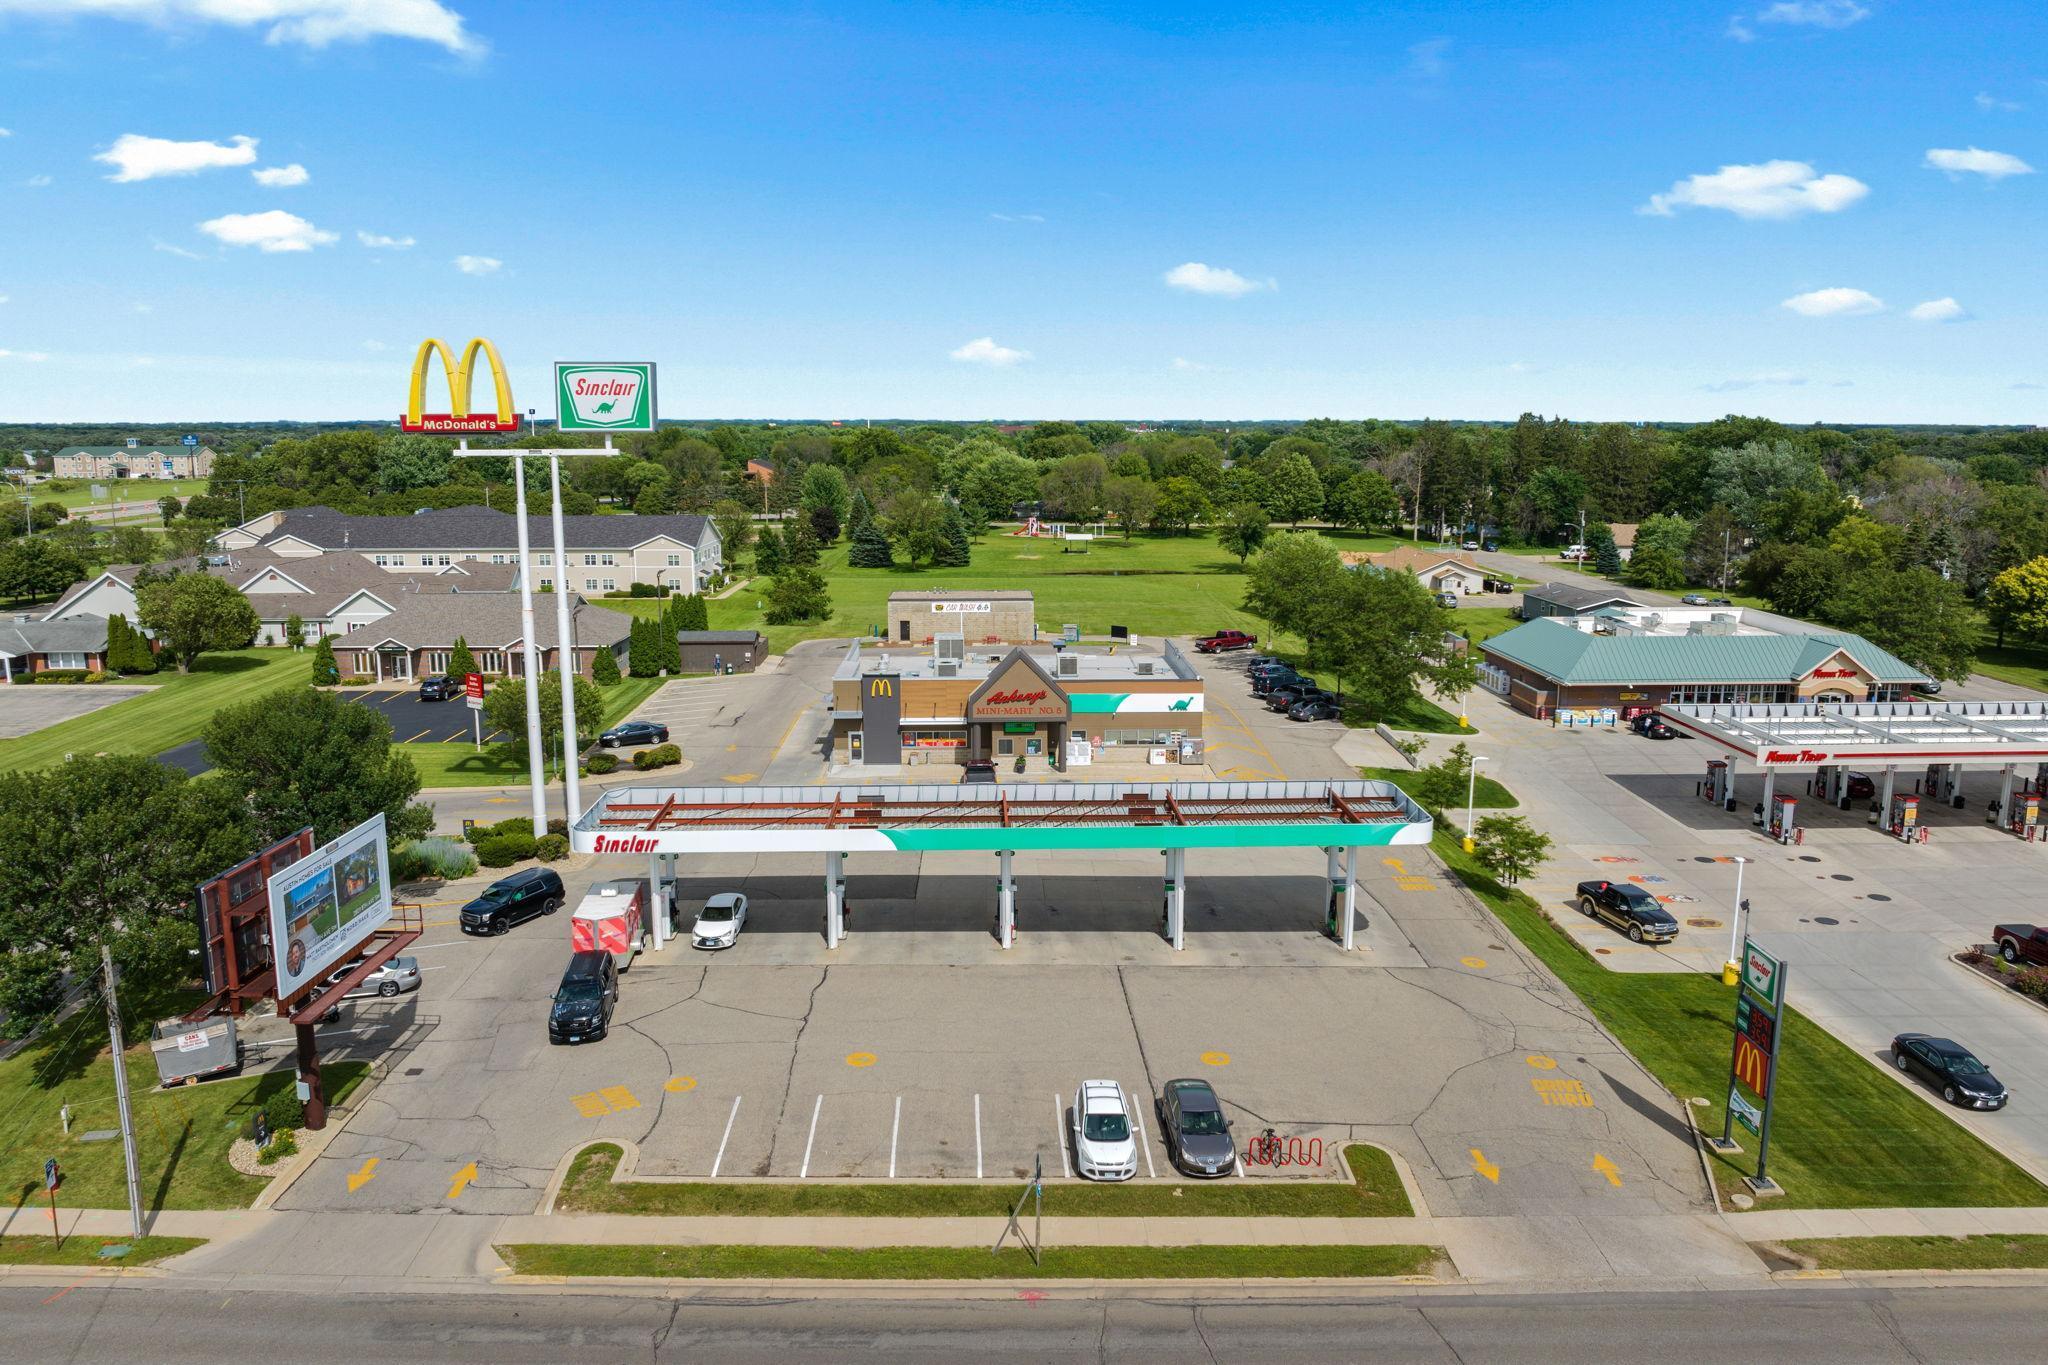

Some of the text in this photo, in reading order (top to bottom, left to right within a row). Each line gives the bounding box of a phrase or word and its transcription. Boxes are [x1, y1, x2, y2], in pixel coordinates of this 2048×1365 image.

[575, 378, 636, 397] Sinclair
[423, 418, 497, 430] McDonald's
[976, 706, 1033, 715] MINI-MART
[1765, 750, 1828, 763] KWIK TRIP
[594, 834, 659, 853] Sinclair
[1749, 955, 1771, 978] Sinclair
